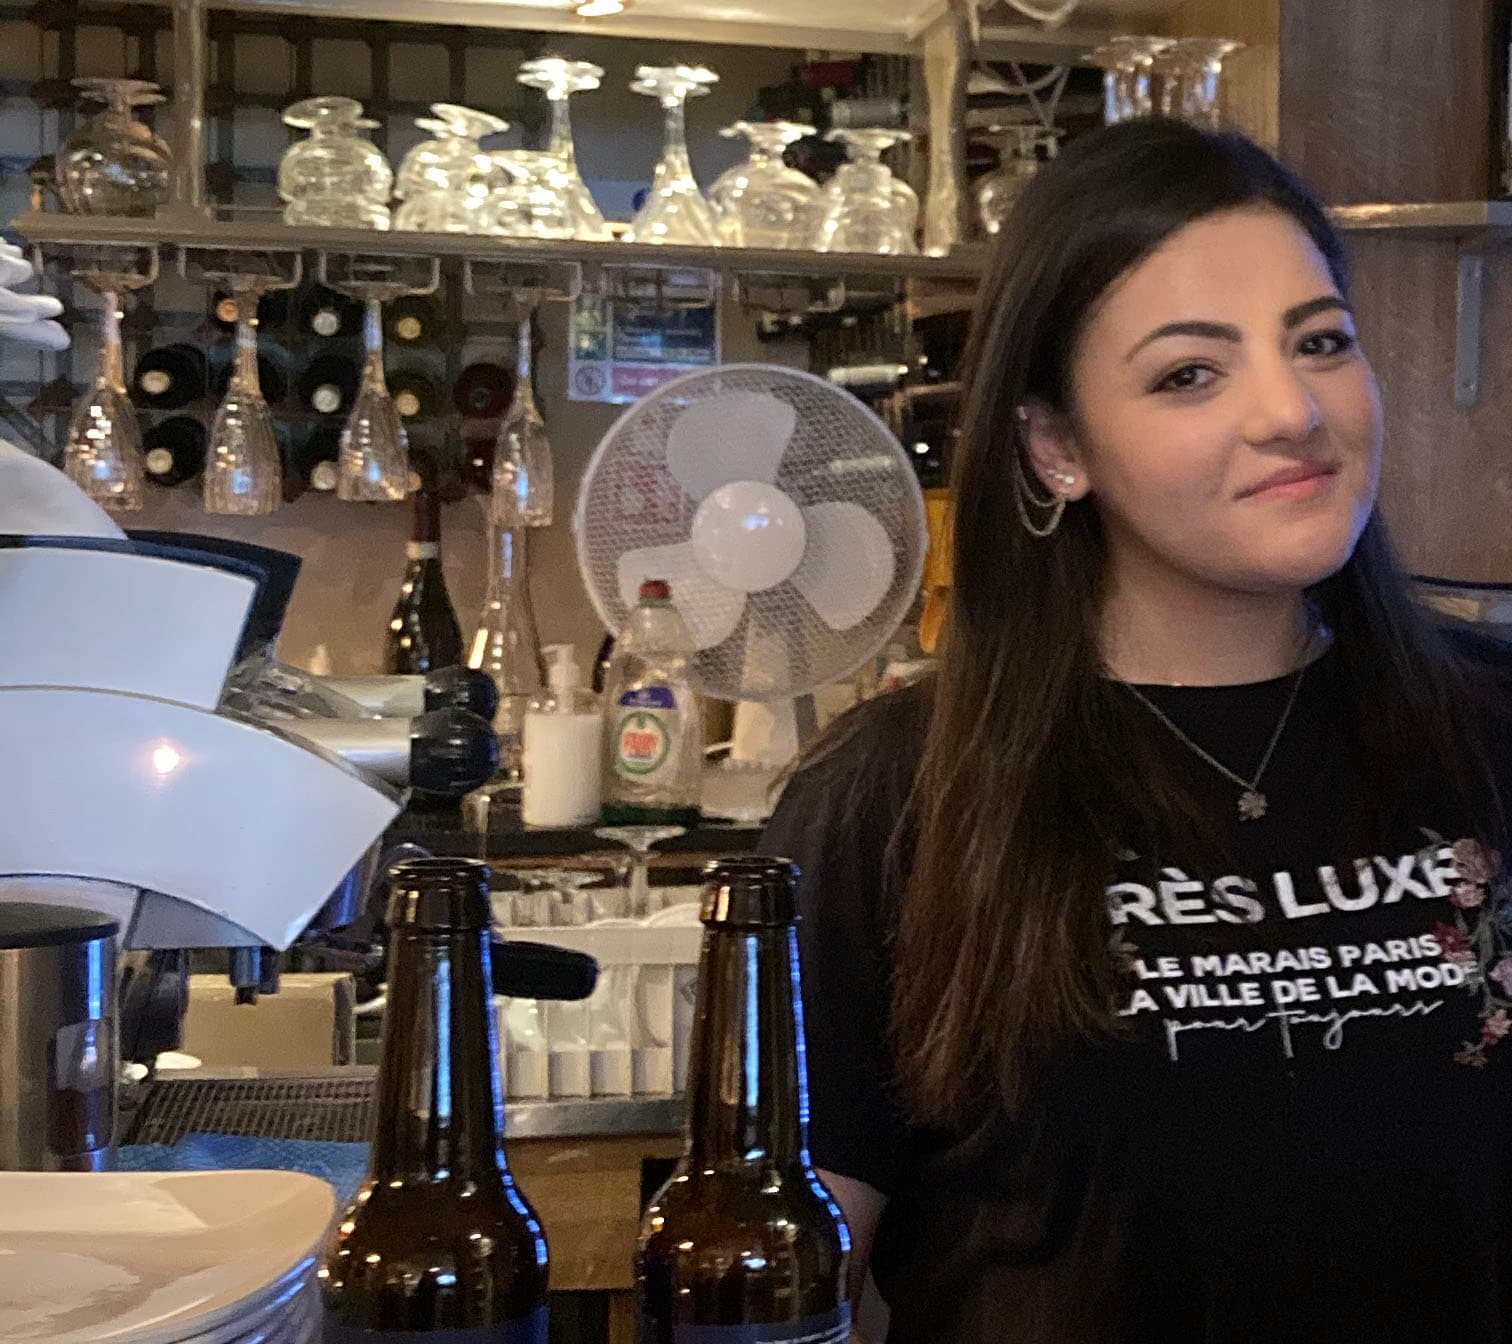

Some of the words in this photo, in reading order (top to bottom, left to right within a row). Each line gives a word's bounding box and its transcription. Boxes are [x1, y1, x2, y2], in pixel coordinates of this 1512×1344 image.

[1273, 847, 1463, 919] LUXE
[1135, 956, 1184, 980] LE
[1190, 946, 1333, 977] MARAIS
[1337, 933, 1443, 968] PARIS
[1162, 981, 1265, 1009] VILLE
[1270, 976, 1322, 1005] DE
[1324, 972, 1381, 999] LA
